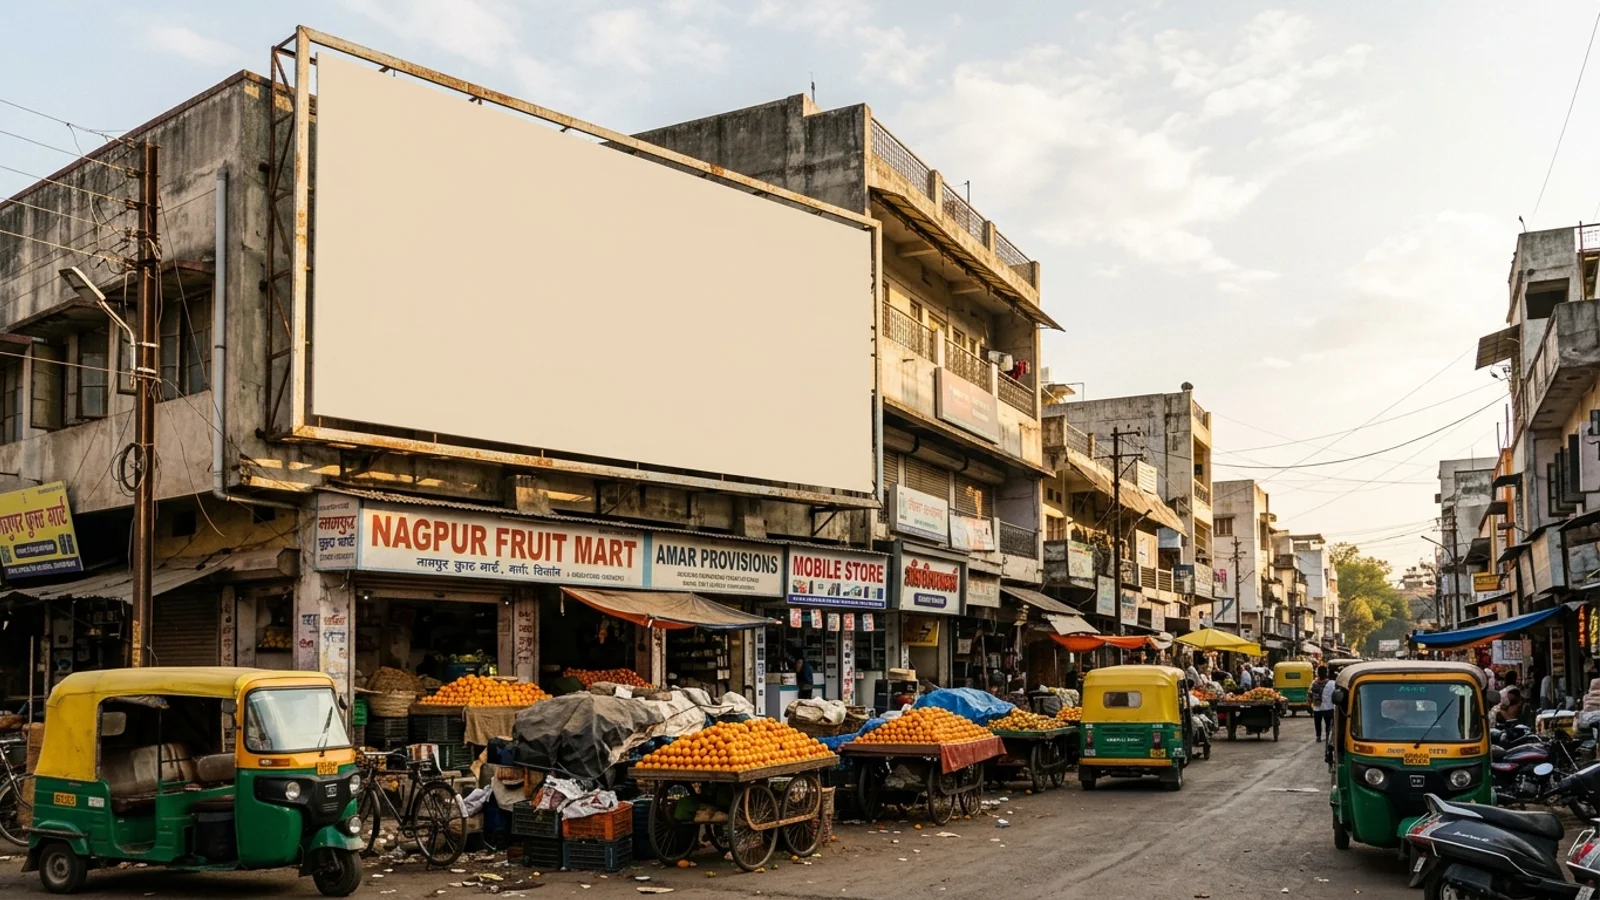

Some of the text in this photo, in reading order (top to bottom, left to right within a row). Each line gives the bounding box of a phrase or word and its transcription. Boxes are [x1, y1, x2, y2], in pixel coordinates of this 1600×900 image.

[371, 514, 637, 568] NAGPUR FRUIT MART
[656, 544, 778, 575] AMAR PROVISIONS
[793, 555, 842, 580] MOBILE
[844, 561, 884, 584] STORE
